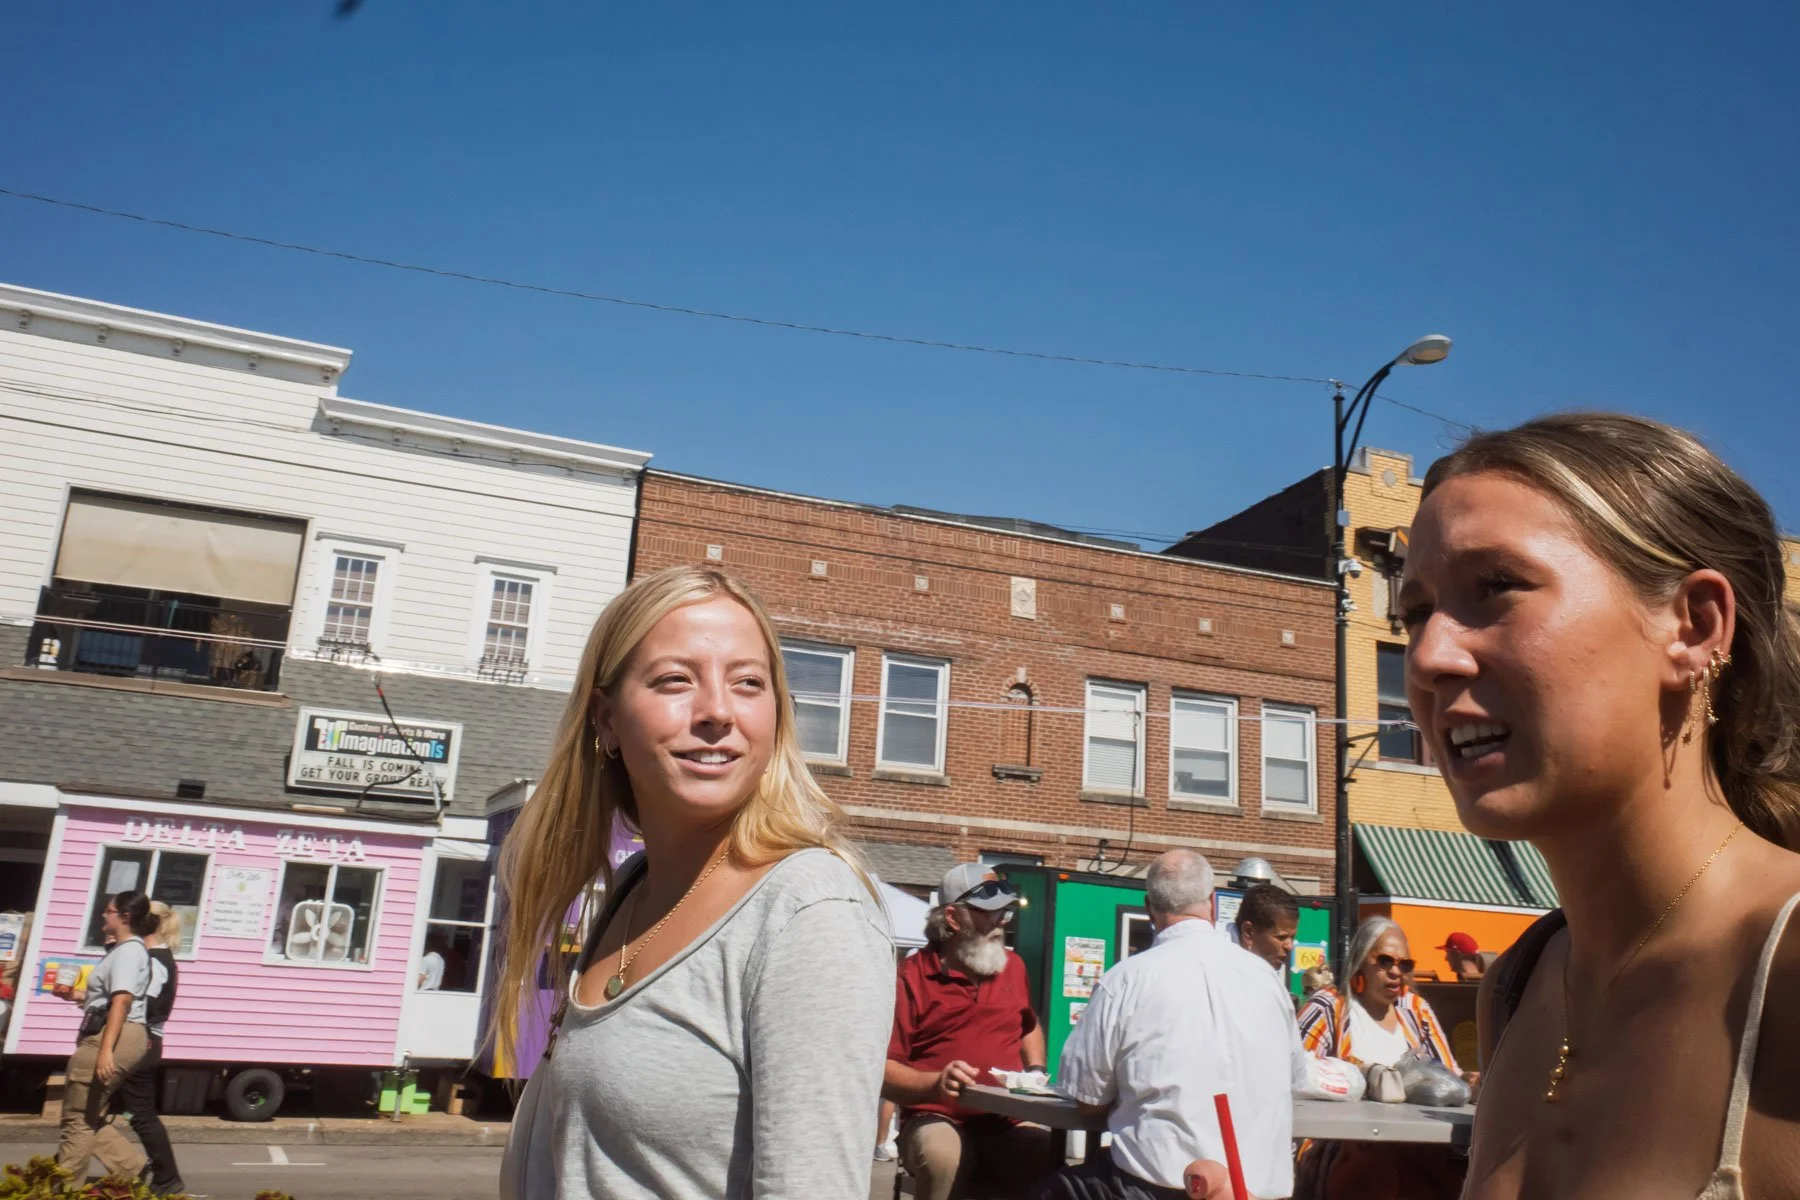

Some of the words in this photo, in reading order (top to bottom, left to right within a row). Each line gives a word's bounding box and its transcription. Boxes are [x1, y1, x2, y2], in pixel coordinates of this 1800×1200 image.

[327, 756, 355, 768] FALL
[362, 760, 374, 770] IS
[380, 761, 422, 774] COMING
[301, 767, 322, 779] GET
[329, 769, 360, 781] YOUR
[409, 777, 446, 789] REAY
[121, 816, 246, 850] DELTA
[274, 828, 365, 861] ZETA
